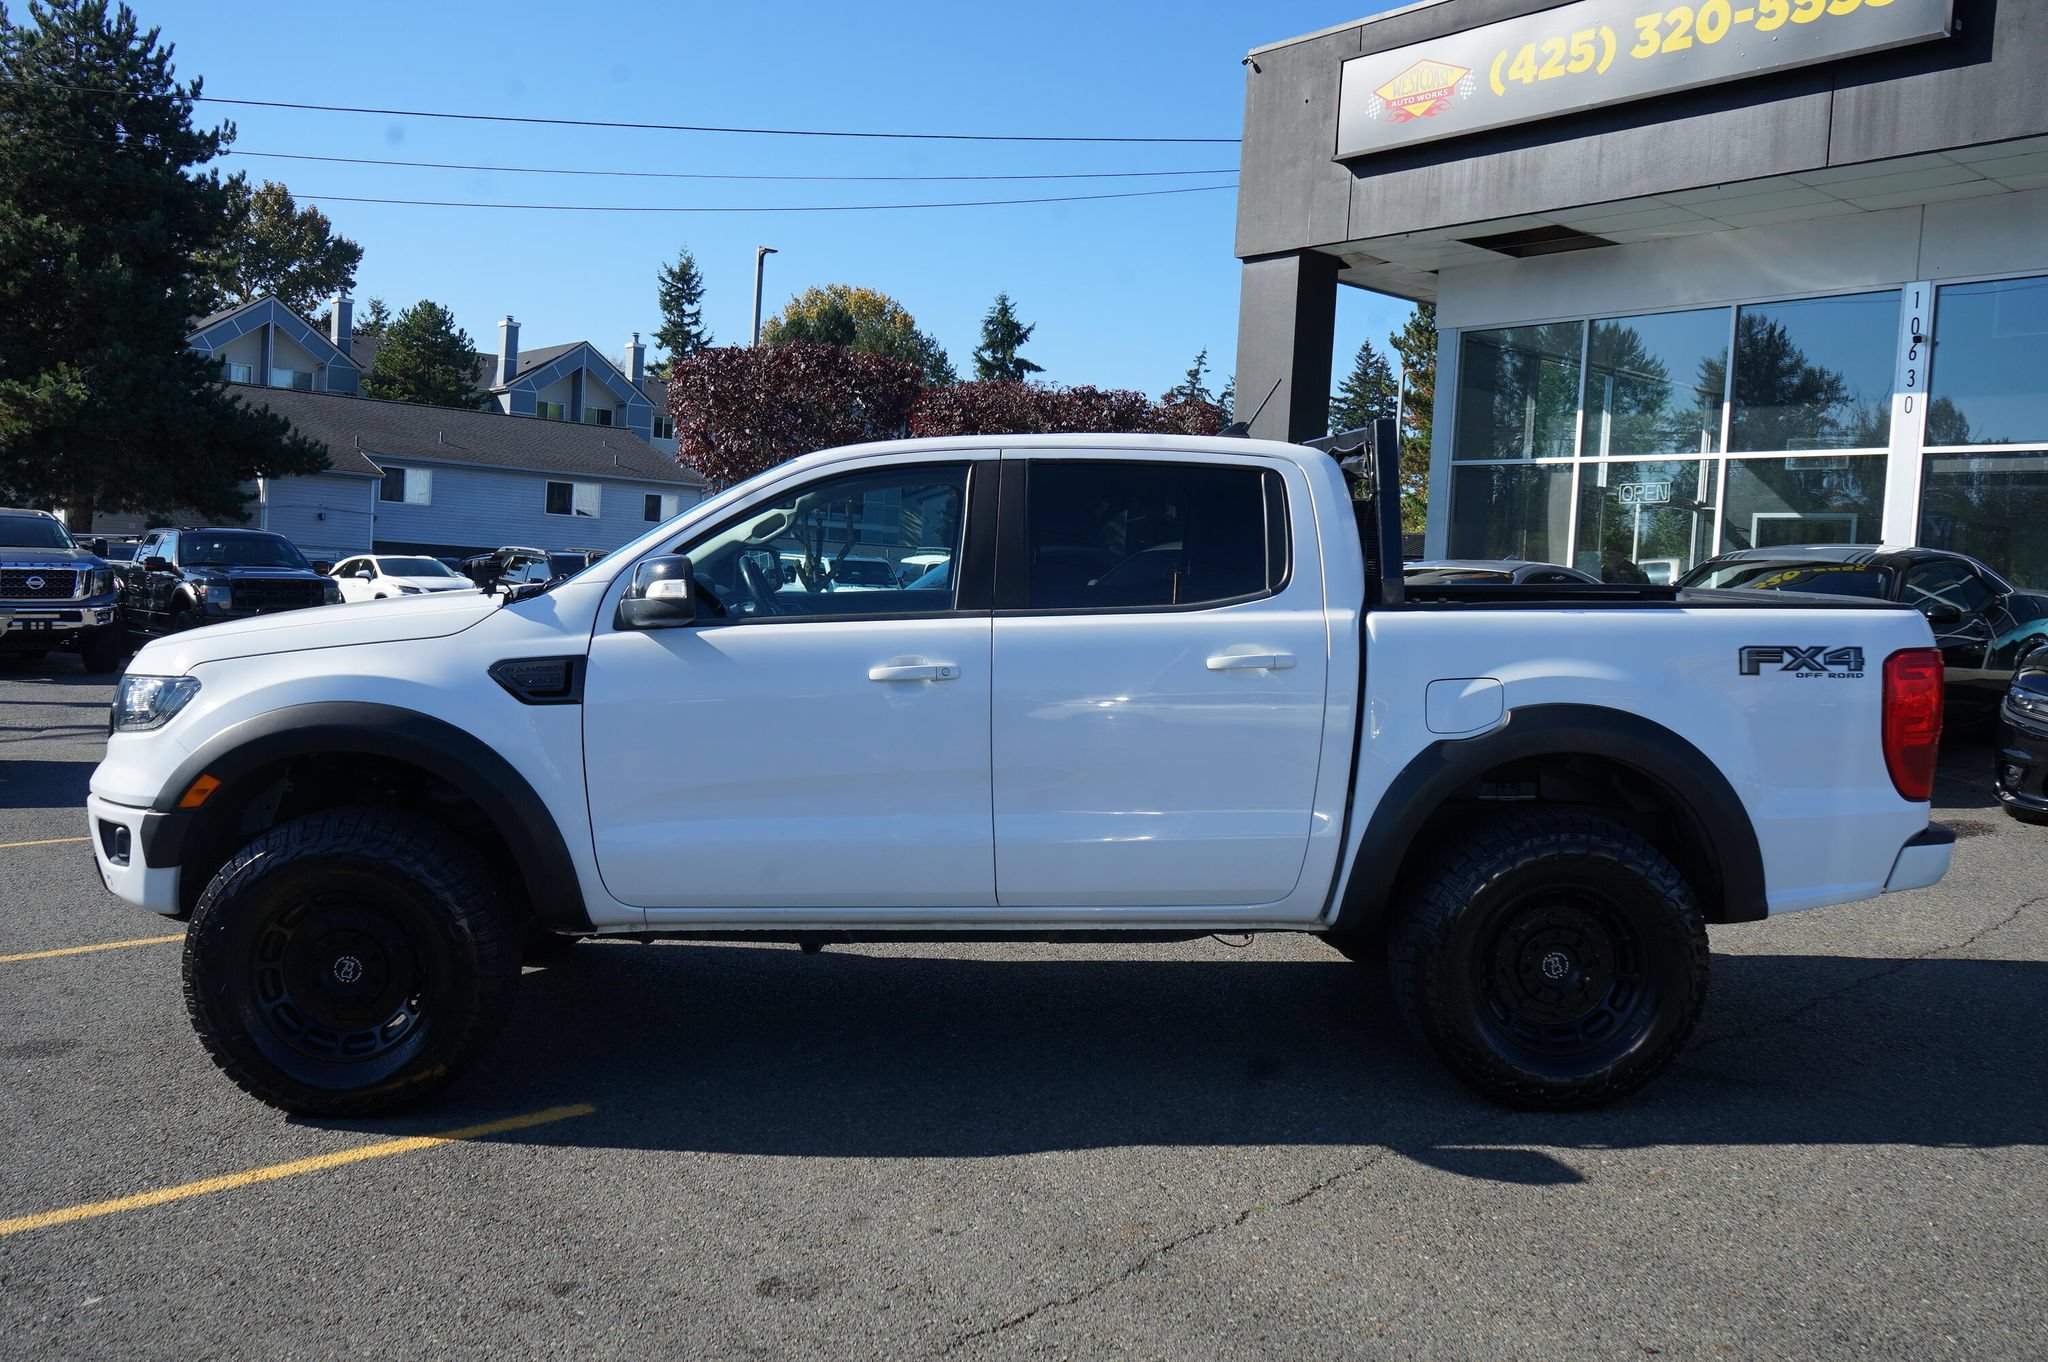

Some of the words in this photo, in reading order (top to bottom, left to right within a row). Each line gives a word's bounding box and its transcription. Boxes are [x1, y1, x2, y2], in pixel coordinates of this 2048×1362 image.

[1489, 26, 1617, 97] (425)
[1391, 97, 1415, 107] AUTO
[1417, 90, 1448, 102] WORKS
[1904, 291, 1920, 414] 10630
[1622, 485, 1668, 501] OPEN
[1738, 645, 1865, 676] FX4
